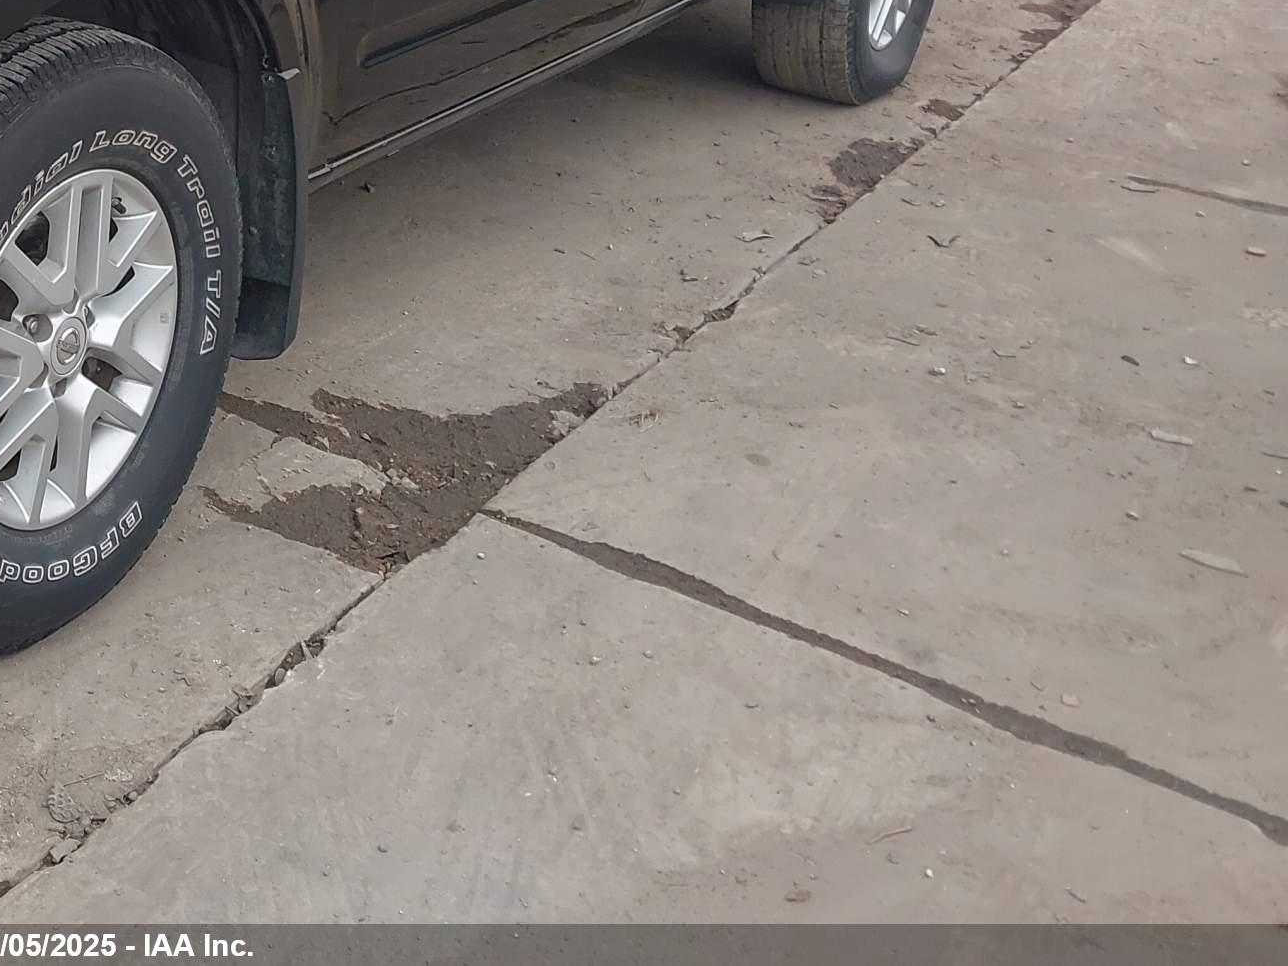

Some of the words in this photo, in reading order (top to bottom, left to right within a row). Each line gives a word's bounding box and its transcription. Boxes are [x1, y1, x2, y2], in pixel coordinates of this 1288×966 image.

[88, 128, 178, 166] Long
[176, 153, 223, 260] Trail
[199, 268, 223, 357] T/A
